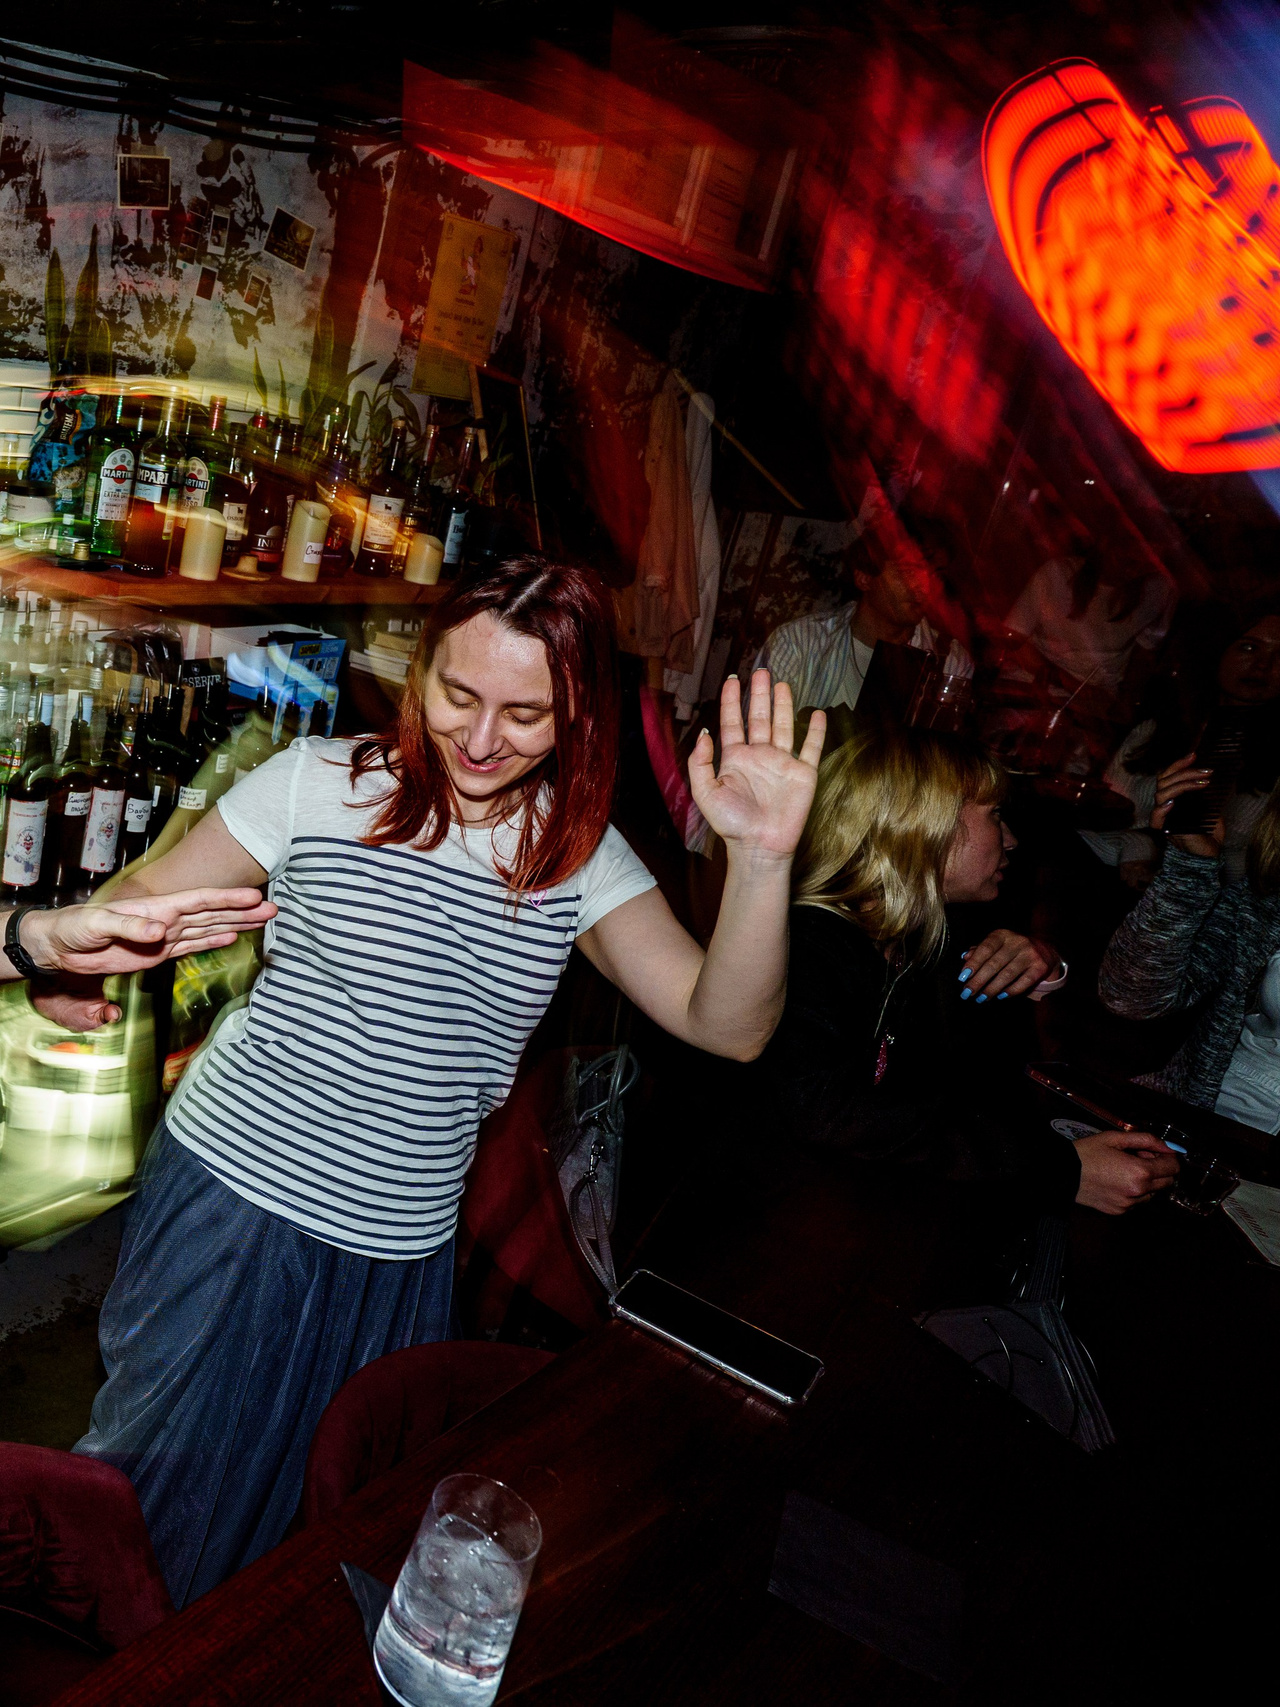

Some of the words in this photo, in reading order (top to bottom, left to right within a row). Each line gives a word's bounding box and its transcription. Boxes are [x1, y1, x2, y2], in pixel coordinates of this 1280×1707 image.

[103, 468, 132, 478] MARTIN
[138, 468, 169, 485] MPARI
[185, 478, 207, 489] ARTINI
